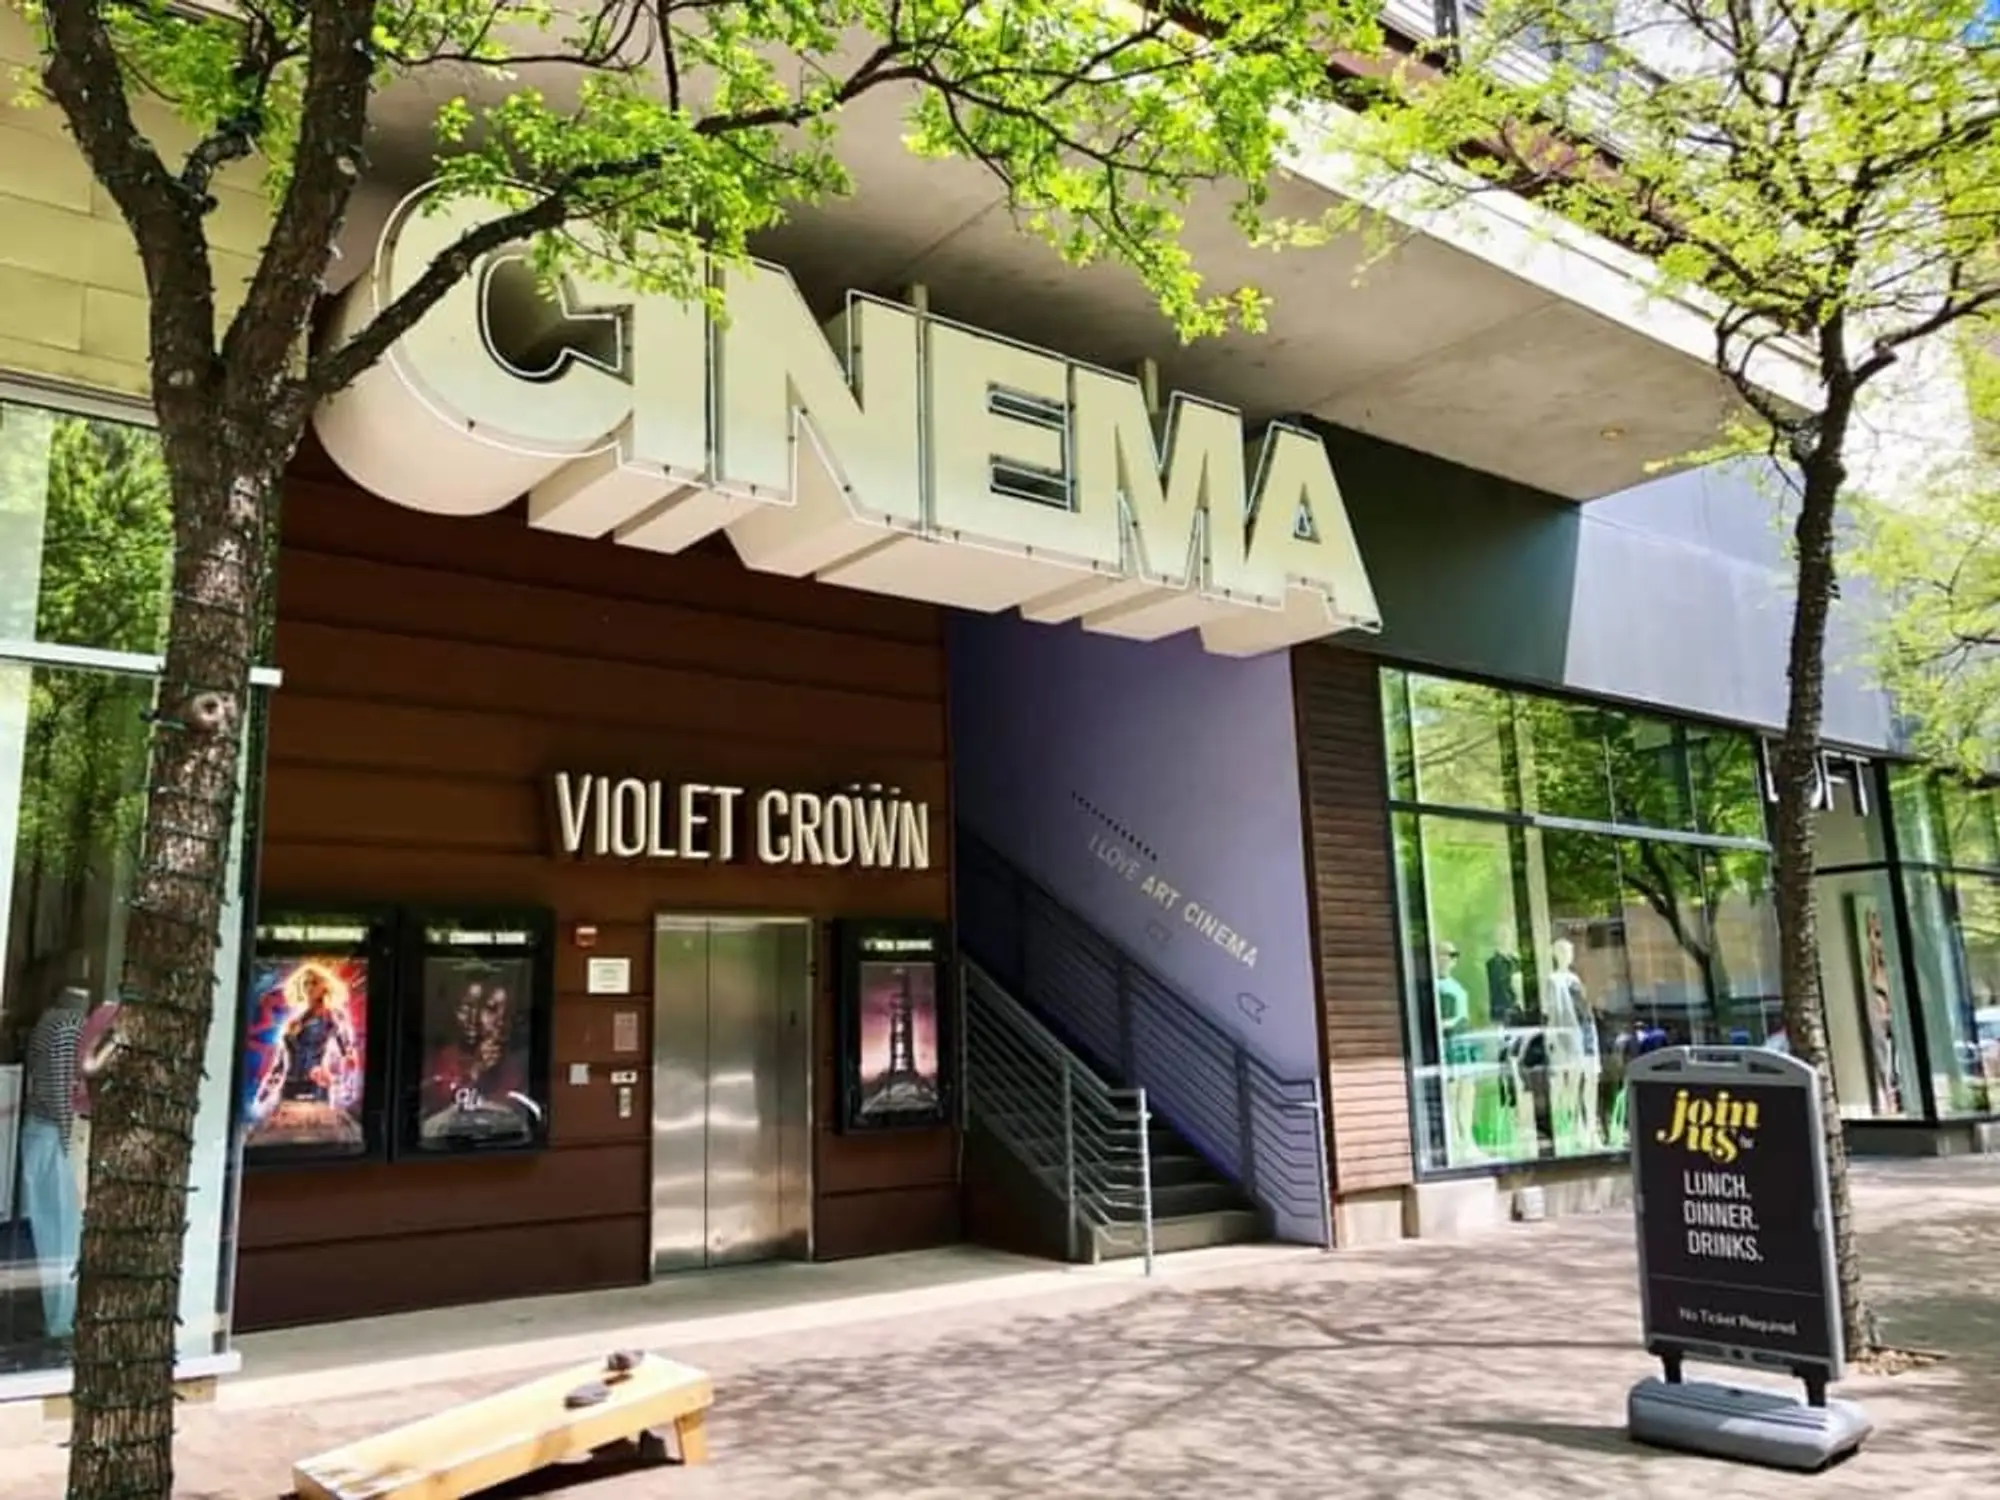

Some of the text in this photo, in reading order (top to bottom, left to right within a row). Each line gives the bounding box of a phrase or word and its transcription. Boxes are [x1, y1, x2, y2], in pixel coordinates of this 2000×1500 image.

[372, 176, 1382, 634] CINEMA
[555, 771, 930, 869] VIOLET CROWN
[1097, 838, 1141, 882] LOVE
[1140, 875, 1183, 911] ART
[1184, 901, 1258, 969] CINEMA
[1656, 1089, 1760, 1143] join
[1686, 1125, 1739, 1164] us
[1683, 1168, 1752, 1199] LUNCH.
[1683, 1200, 1759, 1231] DINNER.
[1687, 1230, 1764, 1262] DRINKS.
